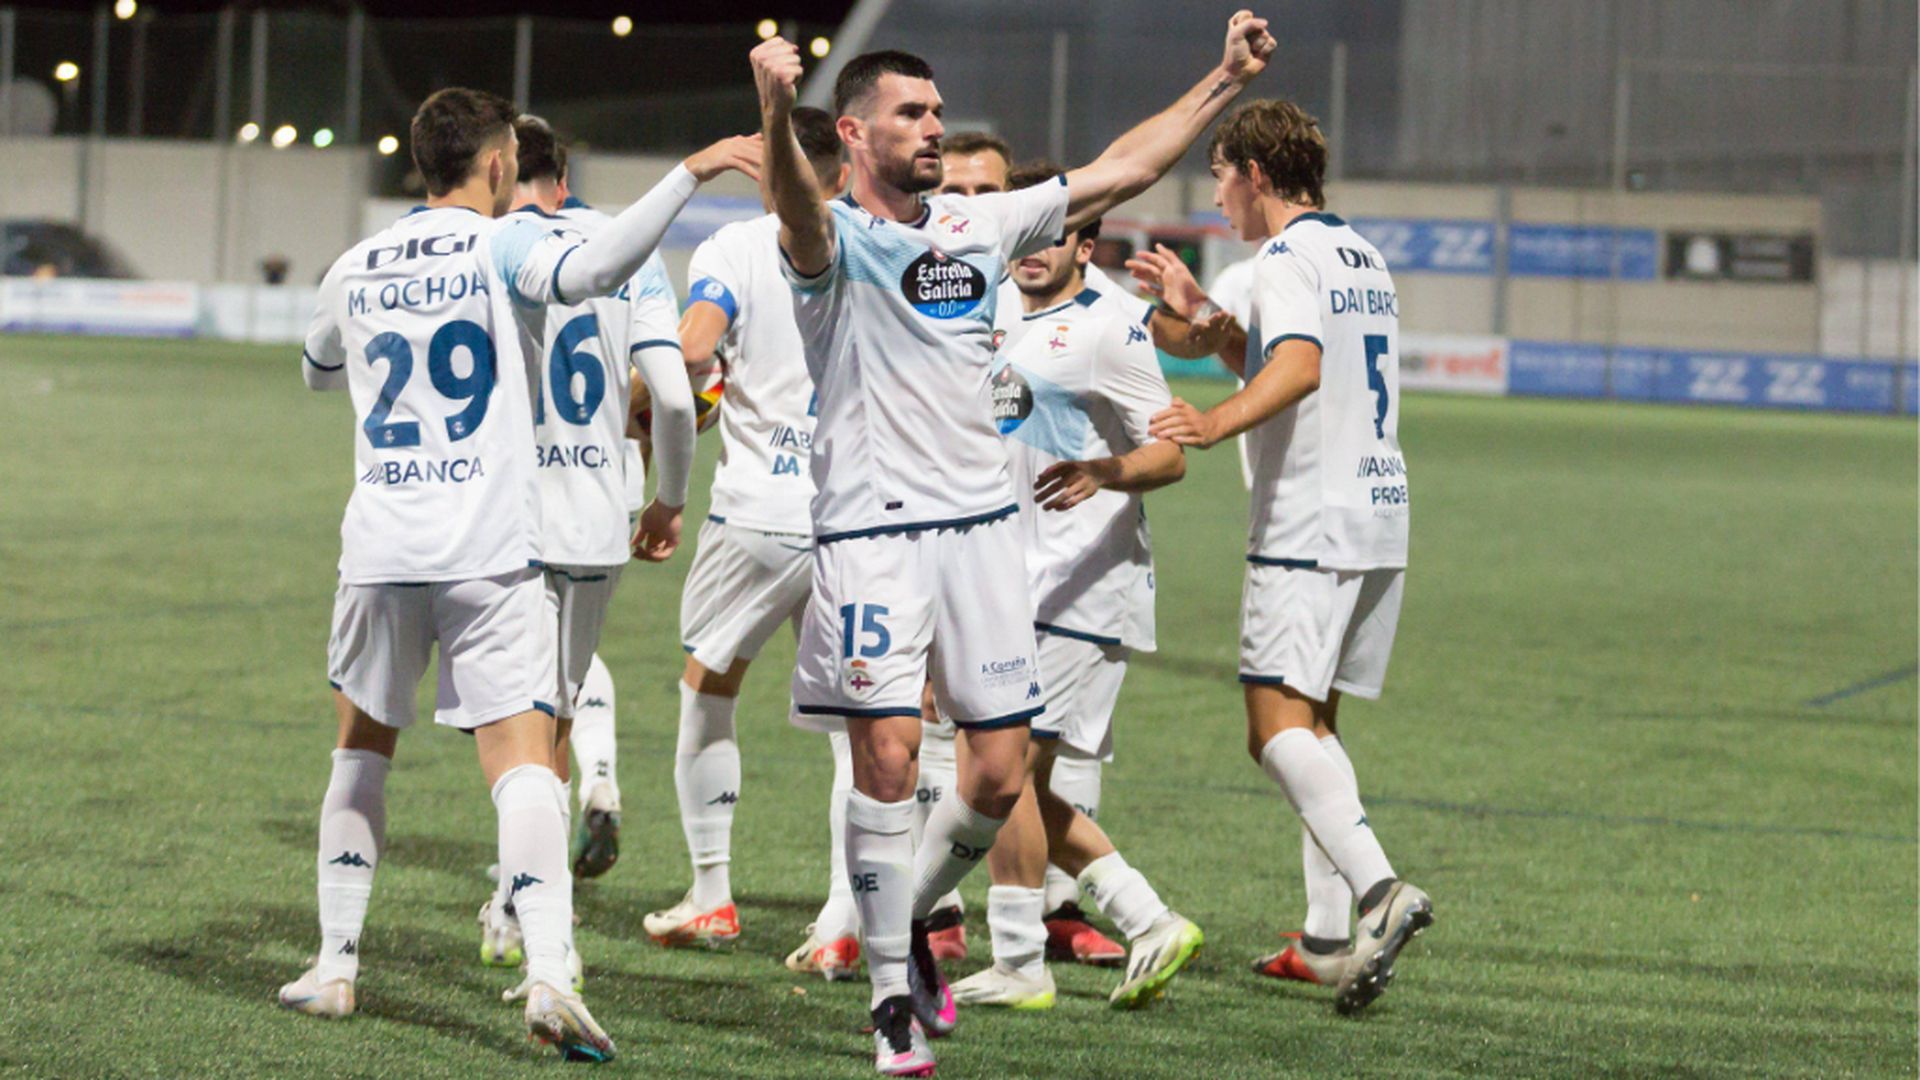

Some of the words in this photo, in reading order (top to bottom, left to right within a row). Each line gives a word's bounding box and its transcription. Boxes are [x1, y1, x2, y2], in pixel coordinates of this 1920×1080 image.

[367, 233, 477, 270] DIGI
[916, 262, 973, 282] Estrella
[918, 281, 972, 300] Galicia
[348, 287, 372, 316] M.
[380, 272, 489, 310] OCHOA
[363, 320, 497, 449] 29
[1363, 334, 1388, 440] 5
[840, 603, 891, 658] 15
[916, 786, 942, 803] DE
[852, 872, 880, 893] DE
